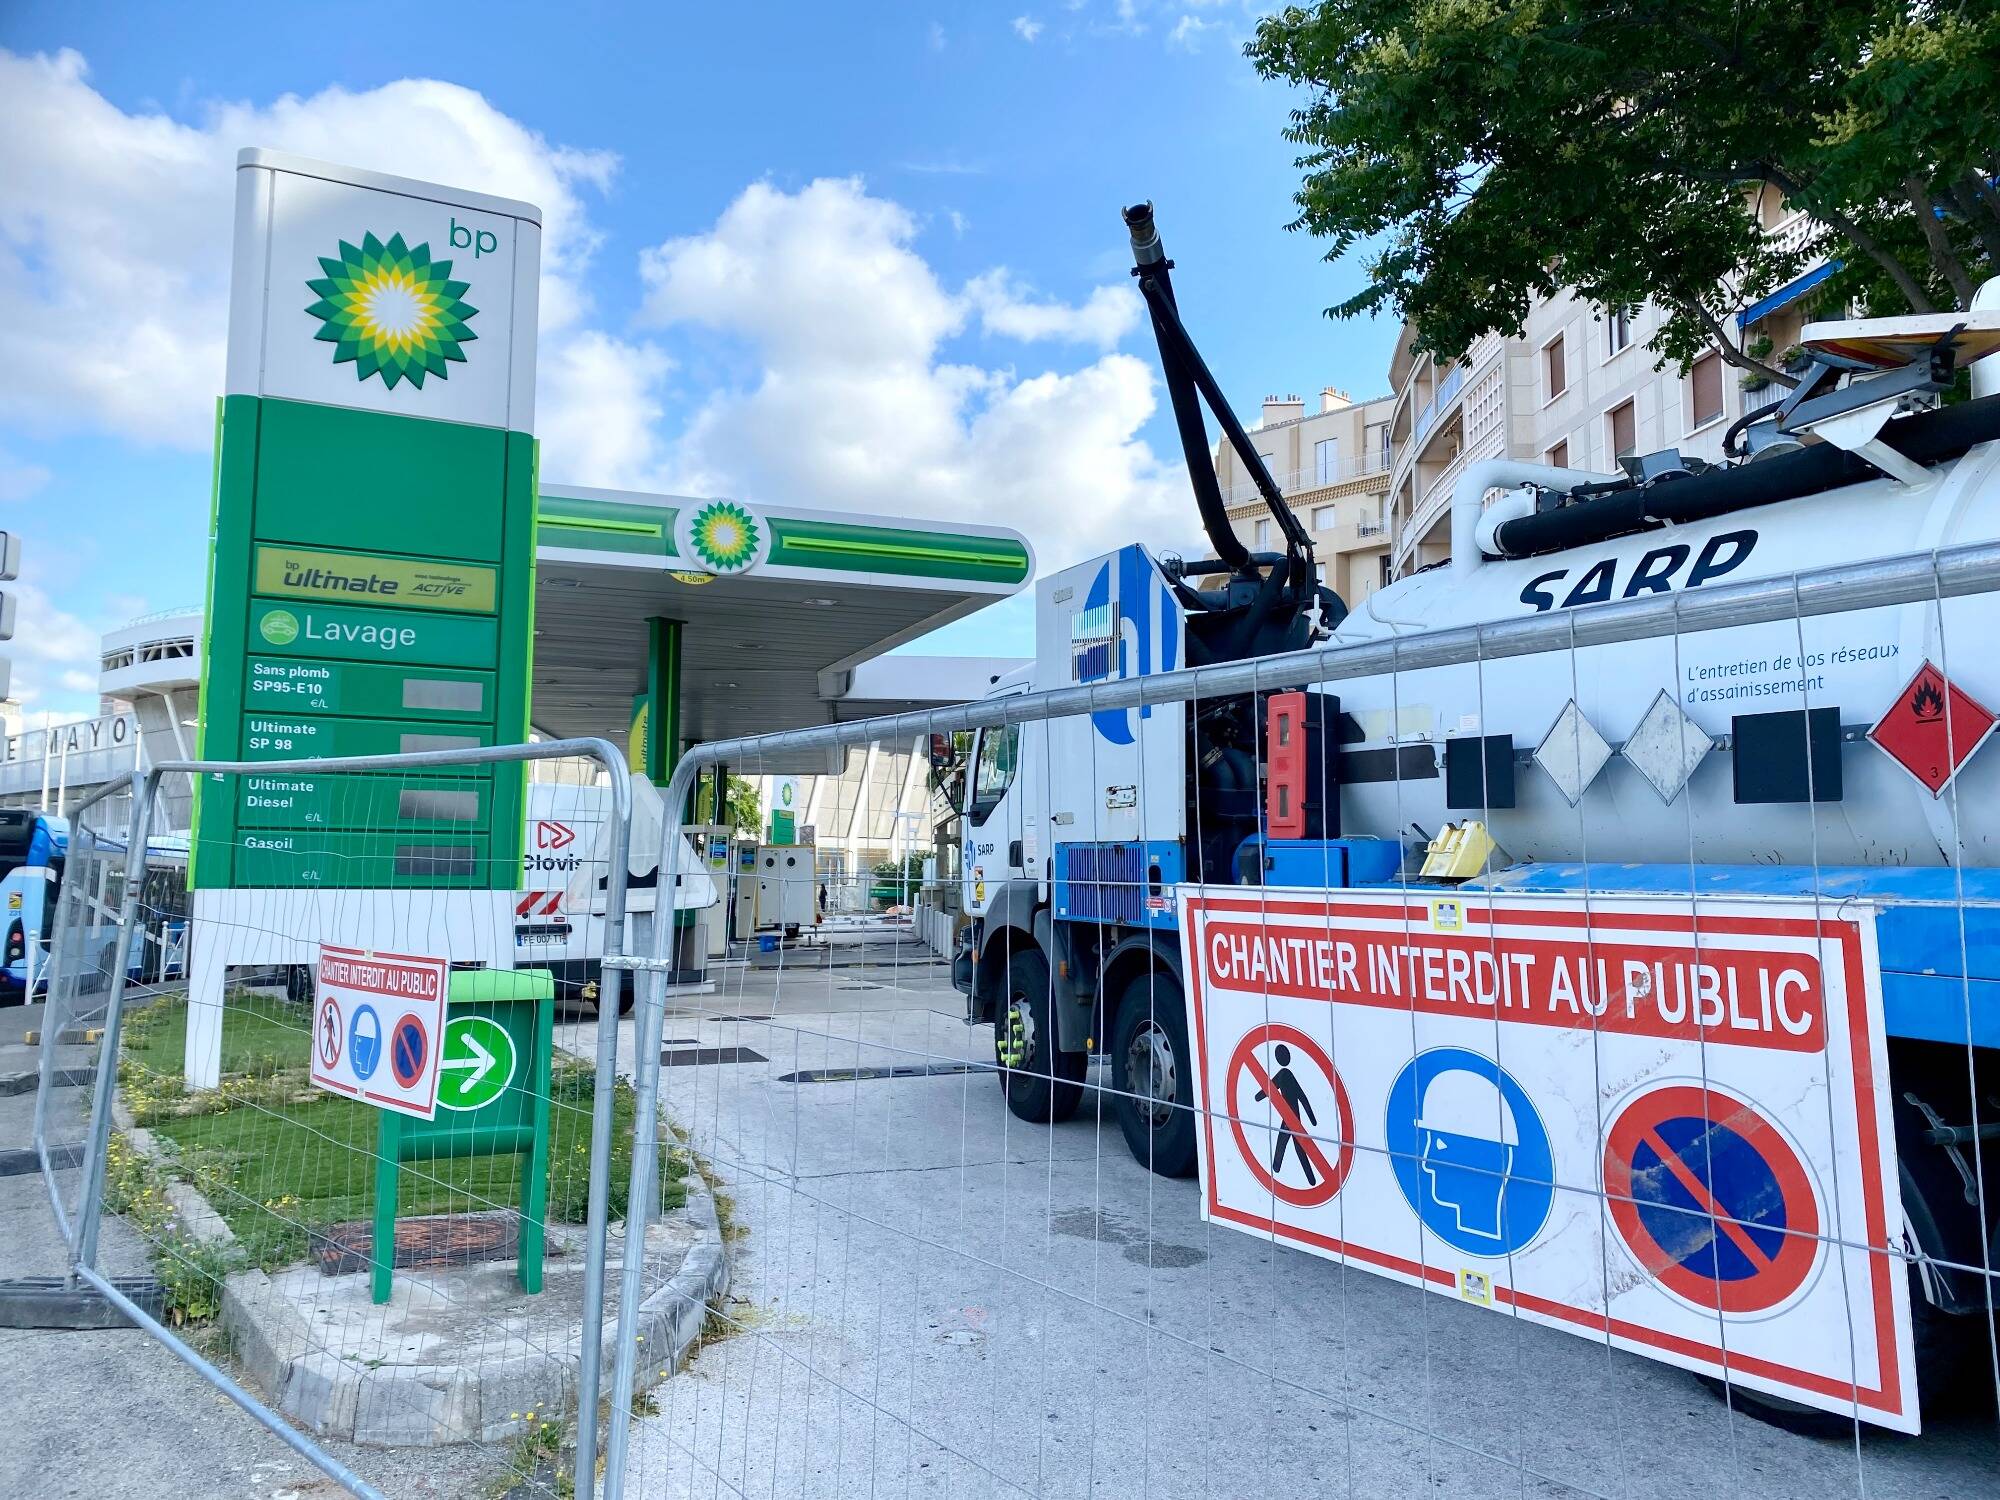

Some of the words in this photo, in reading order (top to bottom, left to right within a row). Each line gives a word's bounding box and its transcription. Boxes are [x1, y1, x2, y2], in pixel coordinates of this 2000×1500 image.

[450, 217, 498, 259] bp
[285, 560, 300, 571] bp
[1519, 529, 1759, 613] SARP
[283, 568, 399, 595] ultimate
[412, 583, 466, 595] ACTIVE
[305, 614, 416, 650] Lavage
[1773, 655, 1791, 671] de
[1831, 643, 1899, 664] réseaux
[253, 663, 286, 676] Sans
[289, 665, 330, 679] plomb
[252, 679, 323, 695] SP95-E10
[310, 698, 329, 709] €/L
[250, 720, 317, 735] Ultimate
[249, 737, 270, 749] SP
[274, 739, 293, 750] 98
[1930, 766, 1939, 778] 3
[248, 778, 314, 792] Ultimate
[247, 795, 293, 808] Diesel
[245, 836, 293, 849] Gasoil
[977, 843, 994, 856] SARP
[321, 959, 351, 984] CHANTIER
[349, 963, 386, 989] INTERDIT
[386, 969, 400, 992] AU
[401, 970, 436, 996] PUBLIC
[1212, 932, 1361, 993] CHANTIER
[1367, 943, 1536, 1009] INTERDIT
[1548, 955, 1608, 1017] AU
[1623, 959, 1813, 1036] PUBLIC
